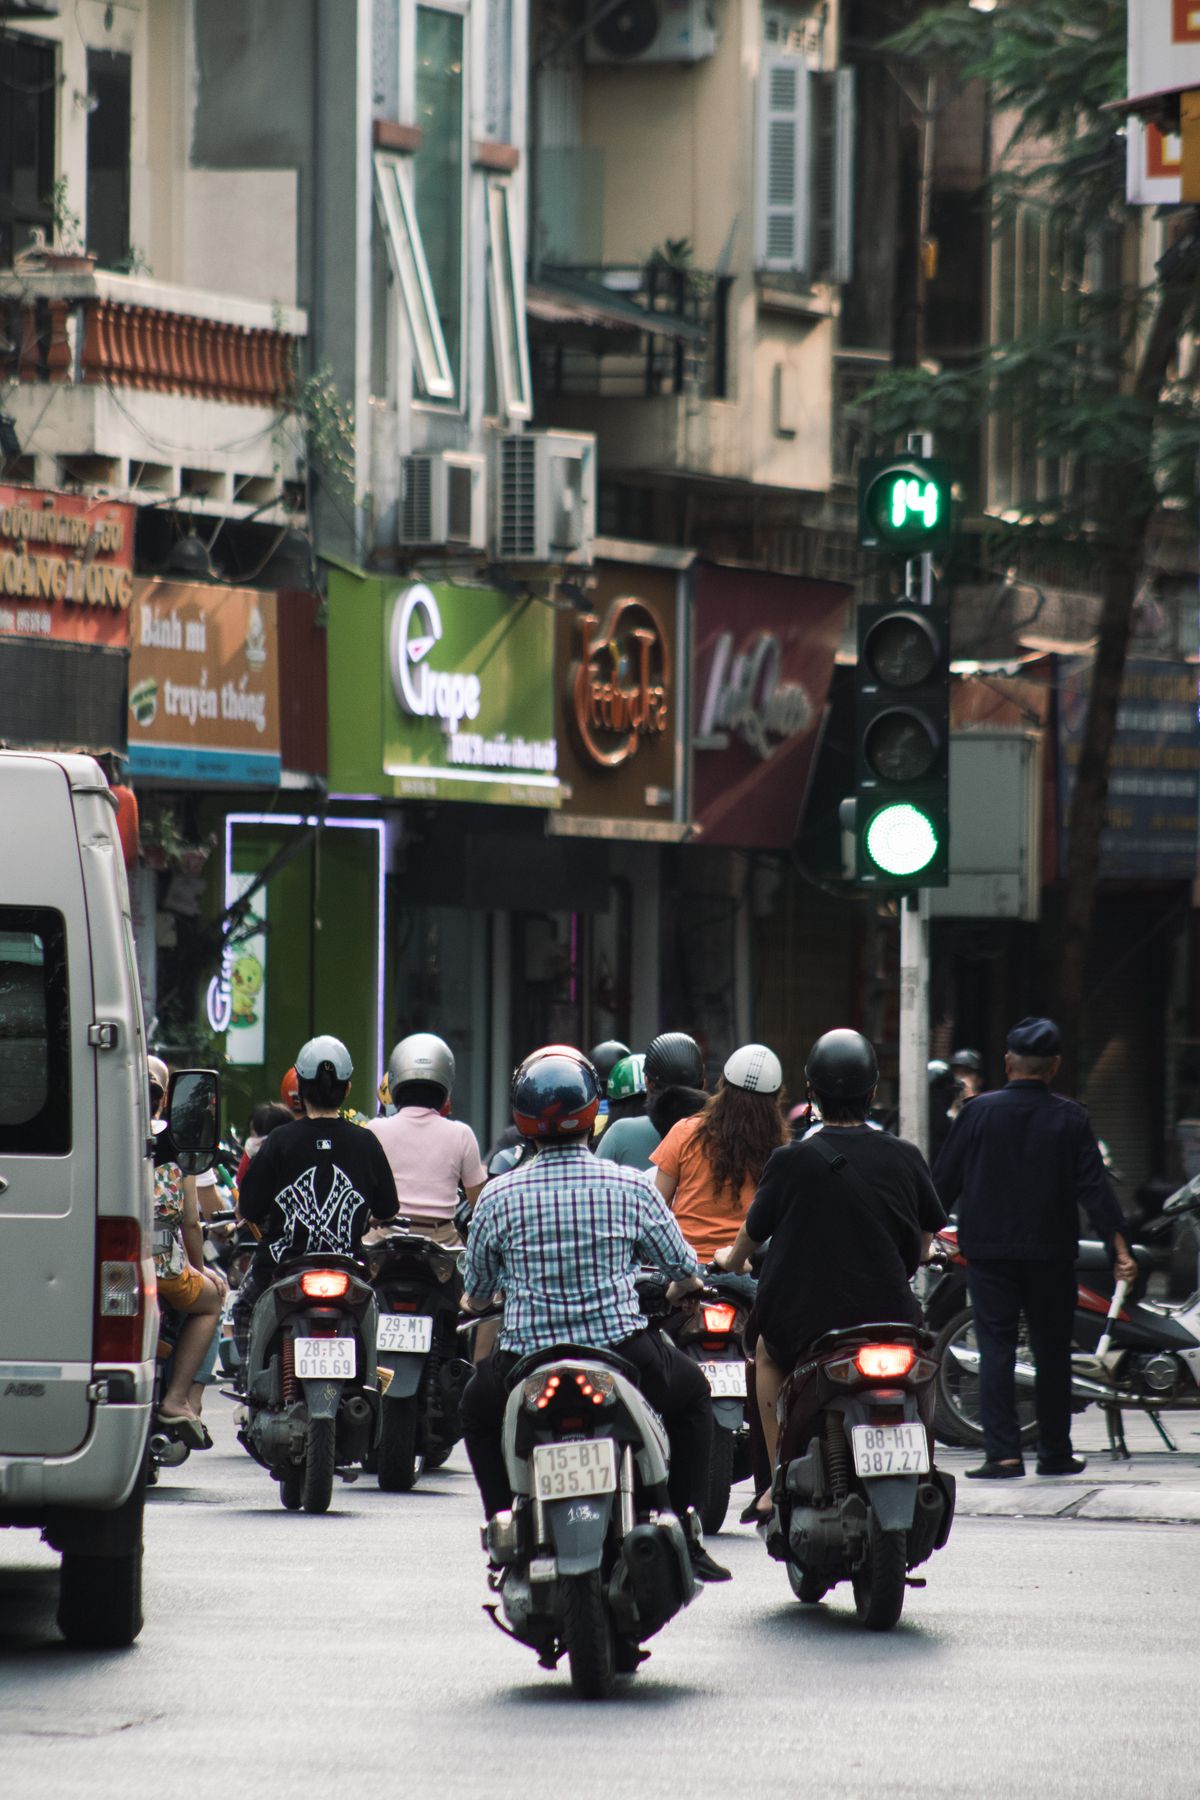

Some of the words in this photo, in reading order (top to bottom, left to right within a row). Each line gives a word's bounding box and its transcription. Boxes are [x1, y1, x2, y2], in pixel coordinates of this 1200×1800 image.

[891, 478, 939, 528] 14
[141, 605, 182, 649] Bánh
[379, 1333, 426, 1350] 572.11
[300, 1360, 351, 1375] 016.69
[864, 1429, 913, 1450] 88-H1
[547, 1444, 600, 1472] 15-B1
[860, 1450, 922, 1473] 387.27
[541, 1467, 609, 1496] 935.17
